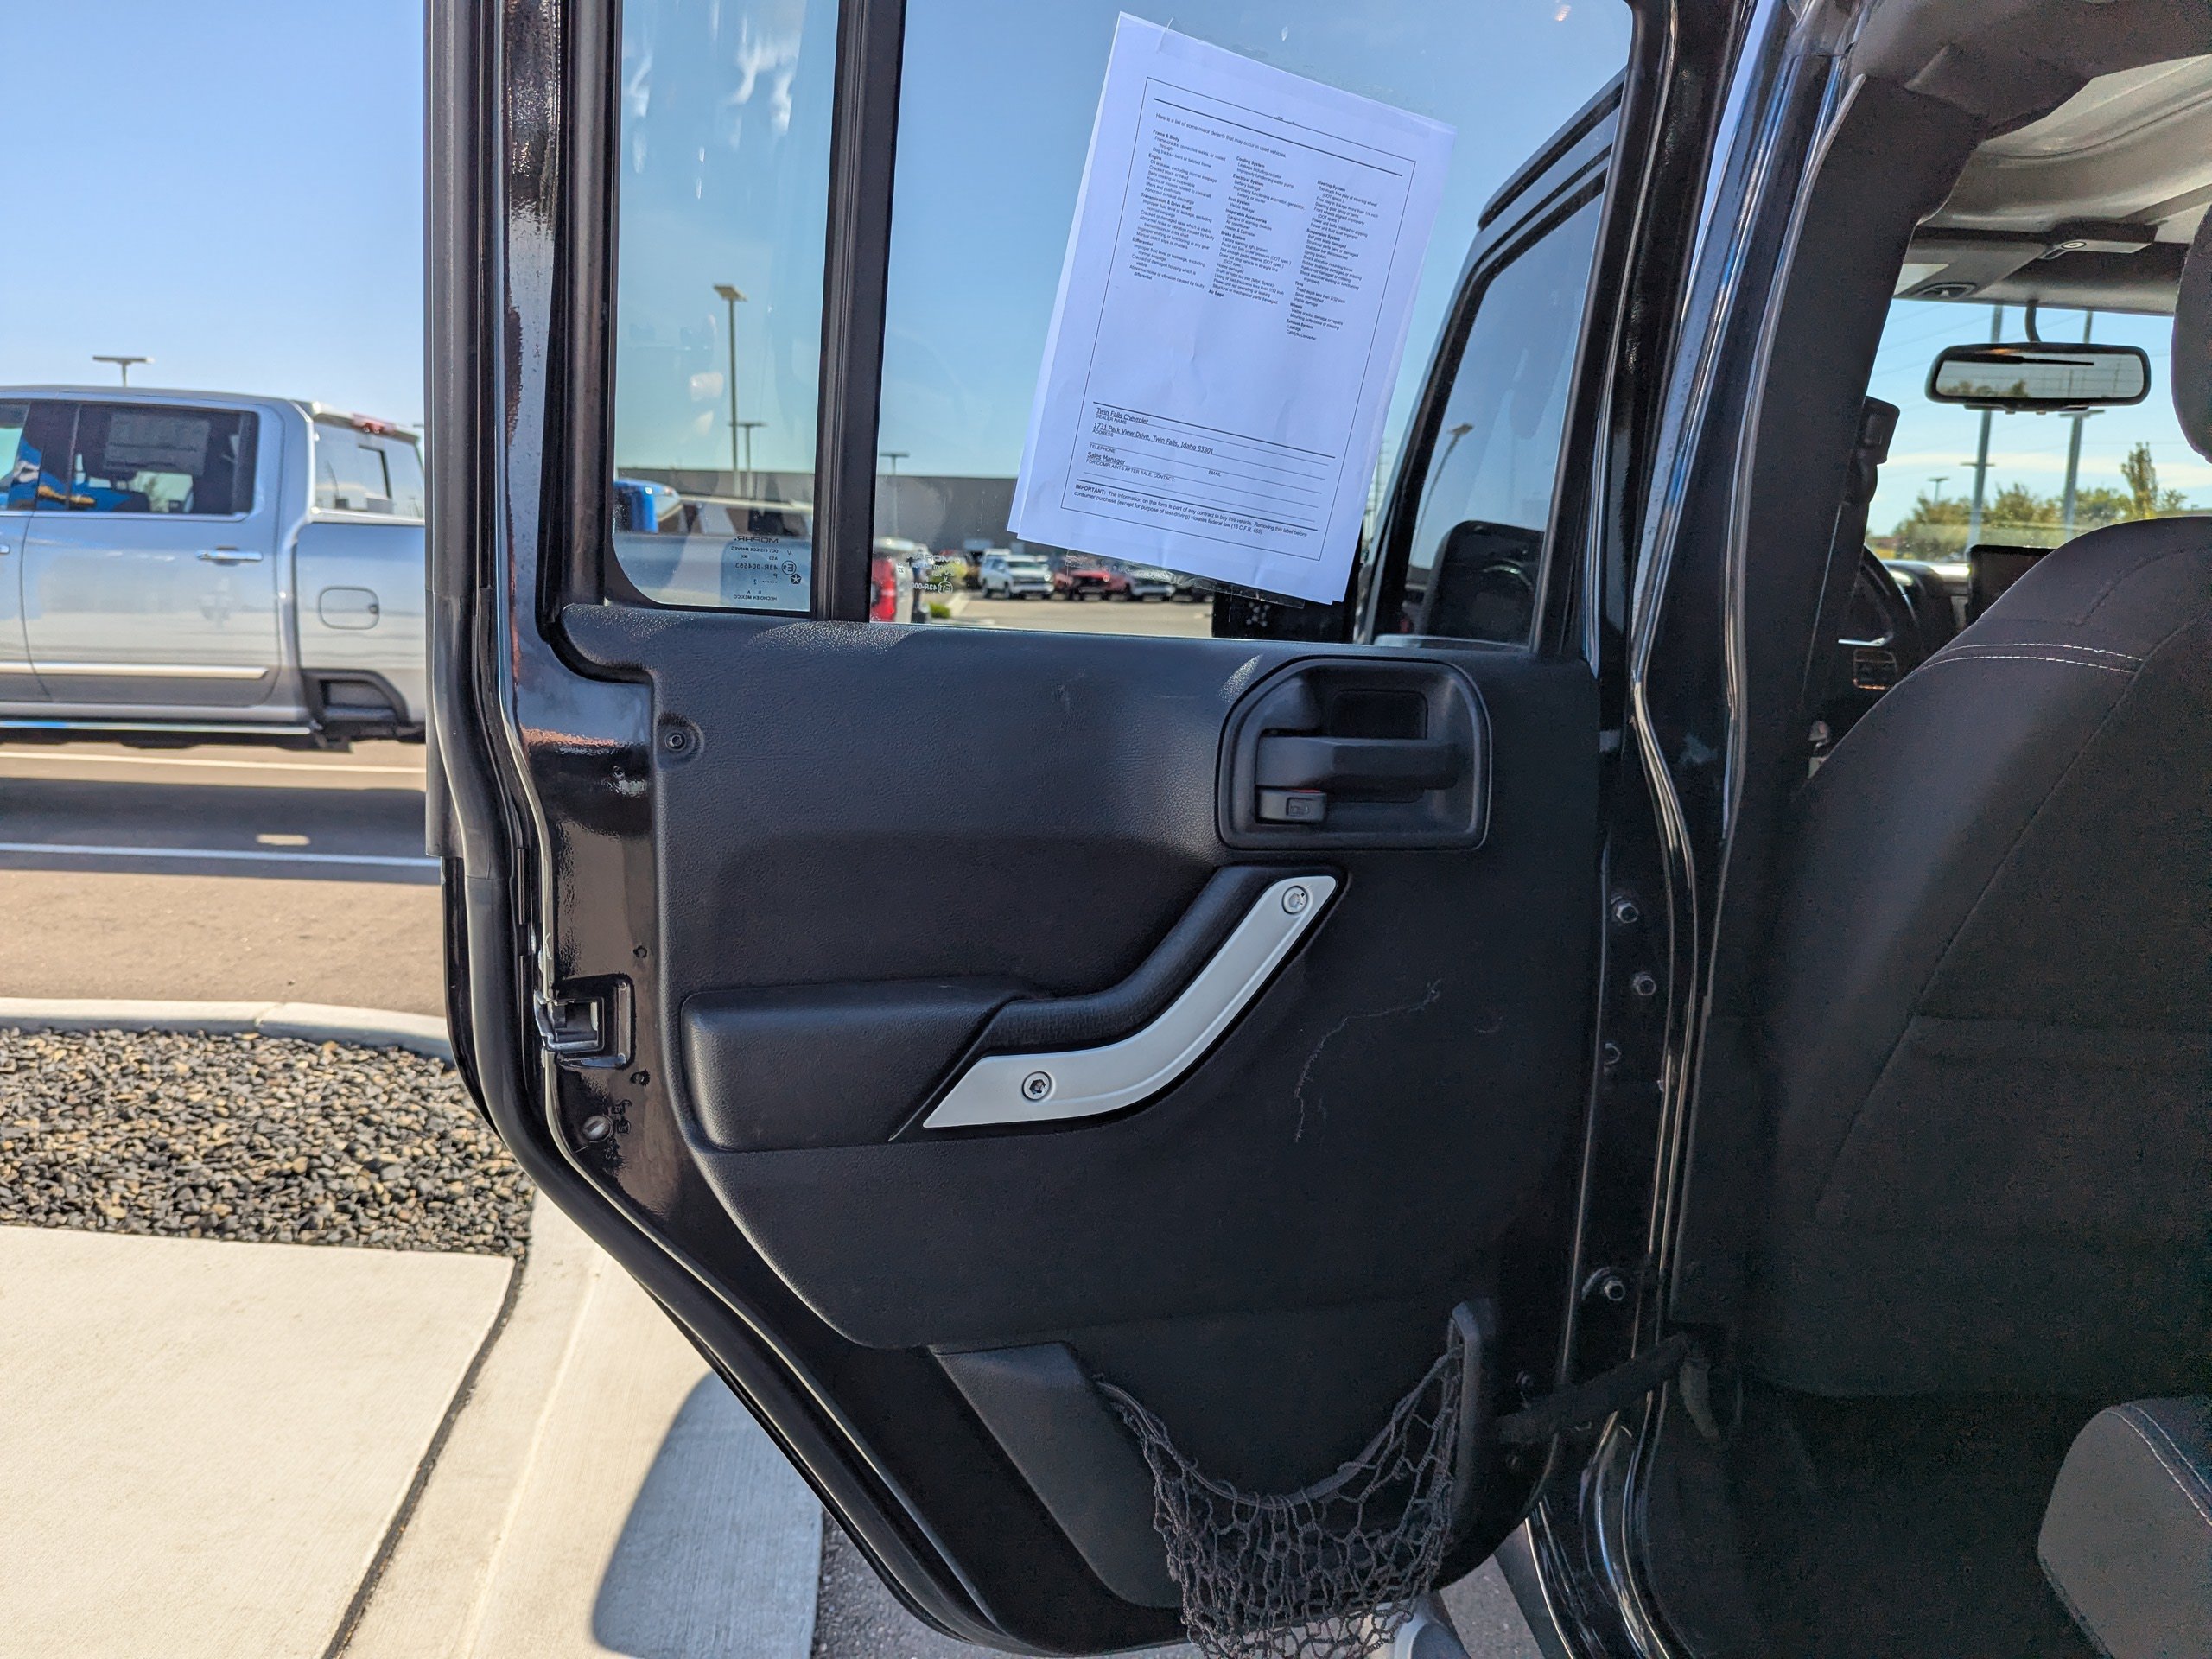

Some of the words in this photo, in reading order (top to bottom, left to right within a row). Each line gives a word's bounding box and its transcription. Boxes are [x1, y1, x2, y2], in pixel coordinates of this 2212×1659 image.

[1198, 126, 1210, 135] major
[1210, 130, 1225, 139] defects
[1147, 152, 1161, 161] Engine
[1236, 156, 1251, 165] Cooling
[1250, 160, 1265, 168] System
[1232, 174, 1249, 182] Electrical
[1249, 179, 1264, 188] System
[1317, 180, 1332, 188] Steering
[1332, 184, 1345, 193] System
[1141, 192, 1166, 203] Transmission
[1225, 207, 1244, 218] Inoperable
[1244, 213, 1267, 223] Accessories
[1306, 228, 1327, 238] Suspension
[1122, 413, 1148, 424] Chevrolet
[1092, 429, 1113, 437] ADDRESS
[1093, 422, 1107, 430] 1731
[1107, 425, 1121, 434] Park
[1121, 428, 1135, 436] View
[1135, 431, 1152, 442] Drive,
[1152, 435, 1165, 443] Twin
[1165, 438, 1180, 448] Falls,
[1179, 442, 1197, 450] Idaho
[1197, 445, 1213, 454] 83301
[1089, 443, 1116, 453] TELEPHONE
[1087, 451, 1102, 460] Sales
[1102, 454, 1125, 466] Manager
[1096, 461, 1124, 471] COMPLAINTS
[1075, 484, 1105, 494] IMPORTANT:
[1116, 493, 1142, 502] information
[1095, 494, 1116, 505] purchase
[1116, 499, 1134, 508] (except
[1140, 505, 1159, 513] purpose
[1164, 509, 1191, 520] test-driving)
[1253, 521, 1274, 531] Removing
